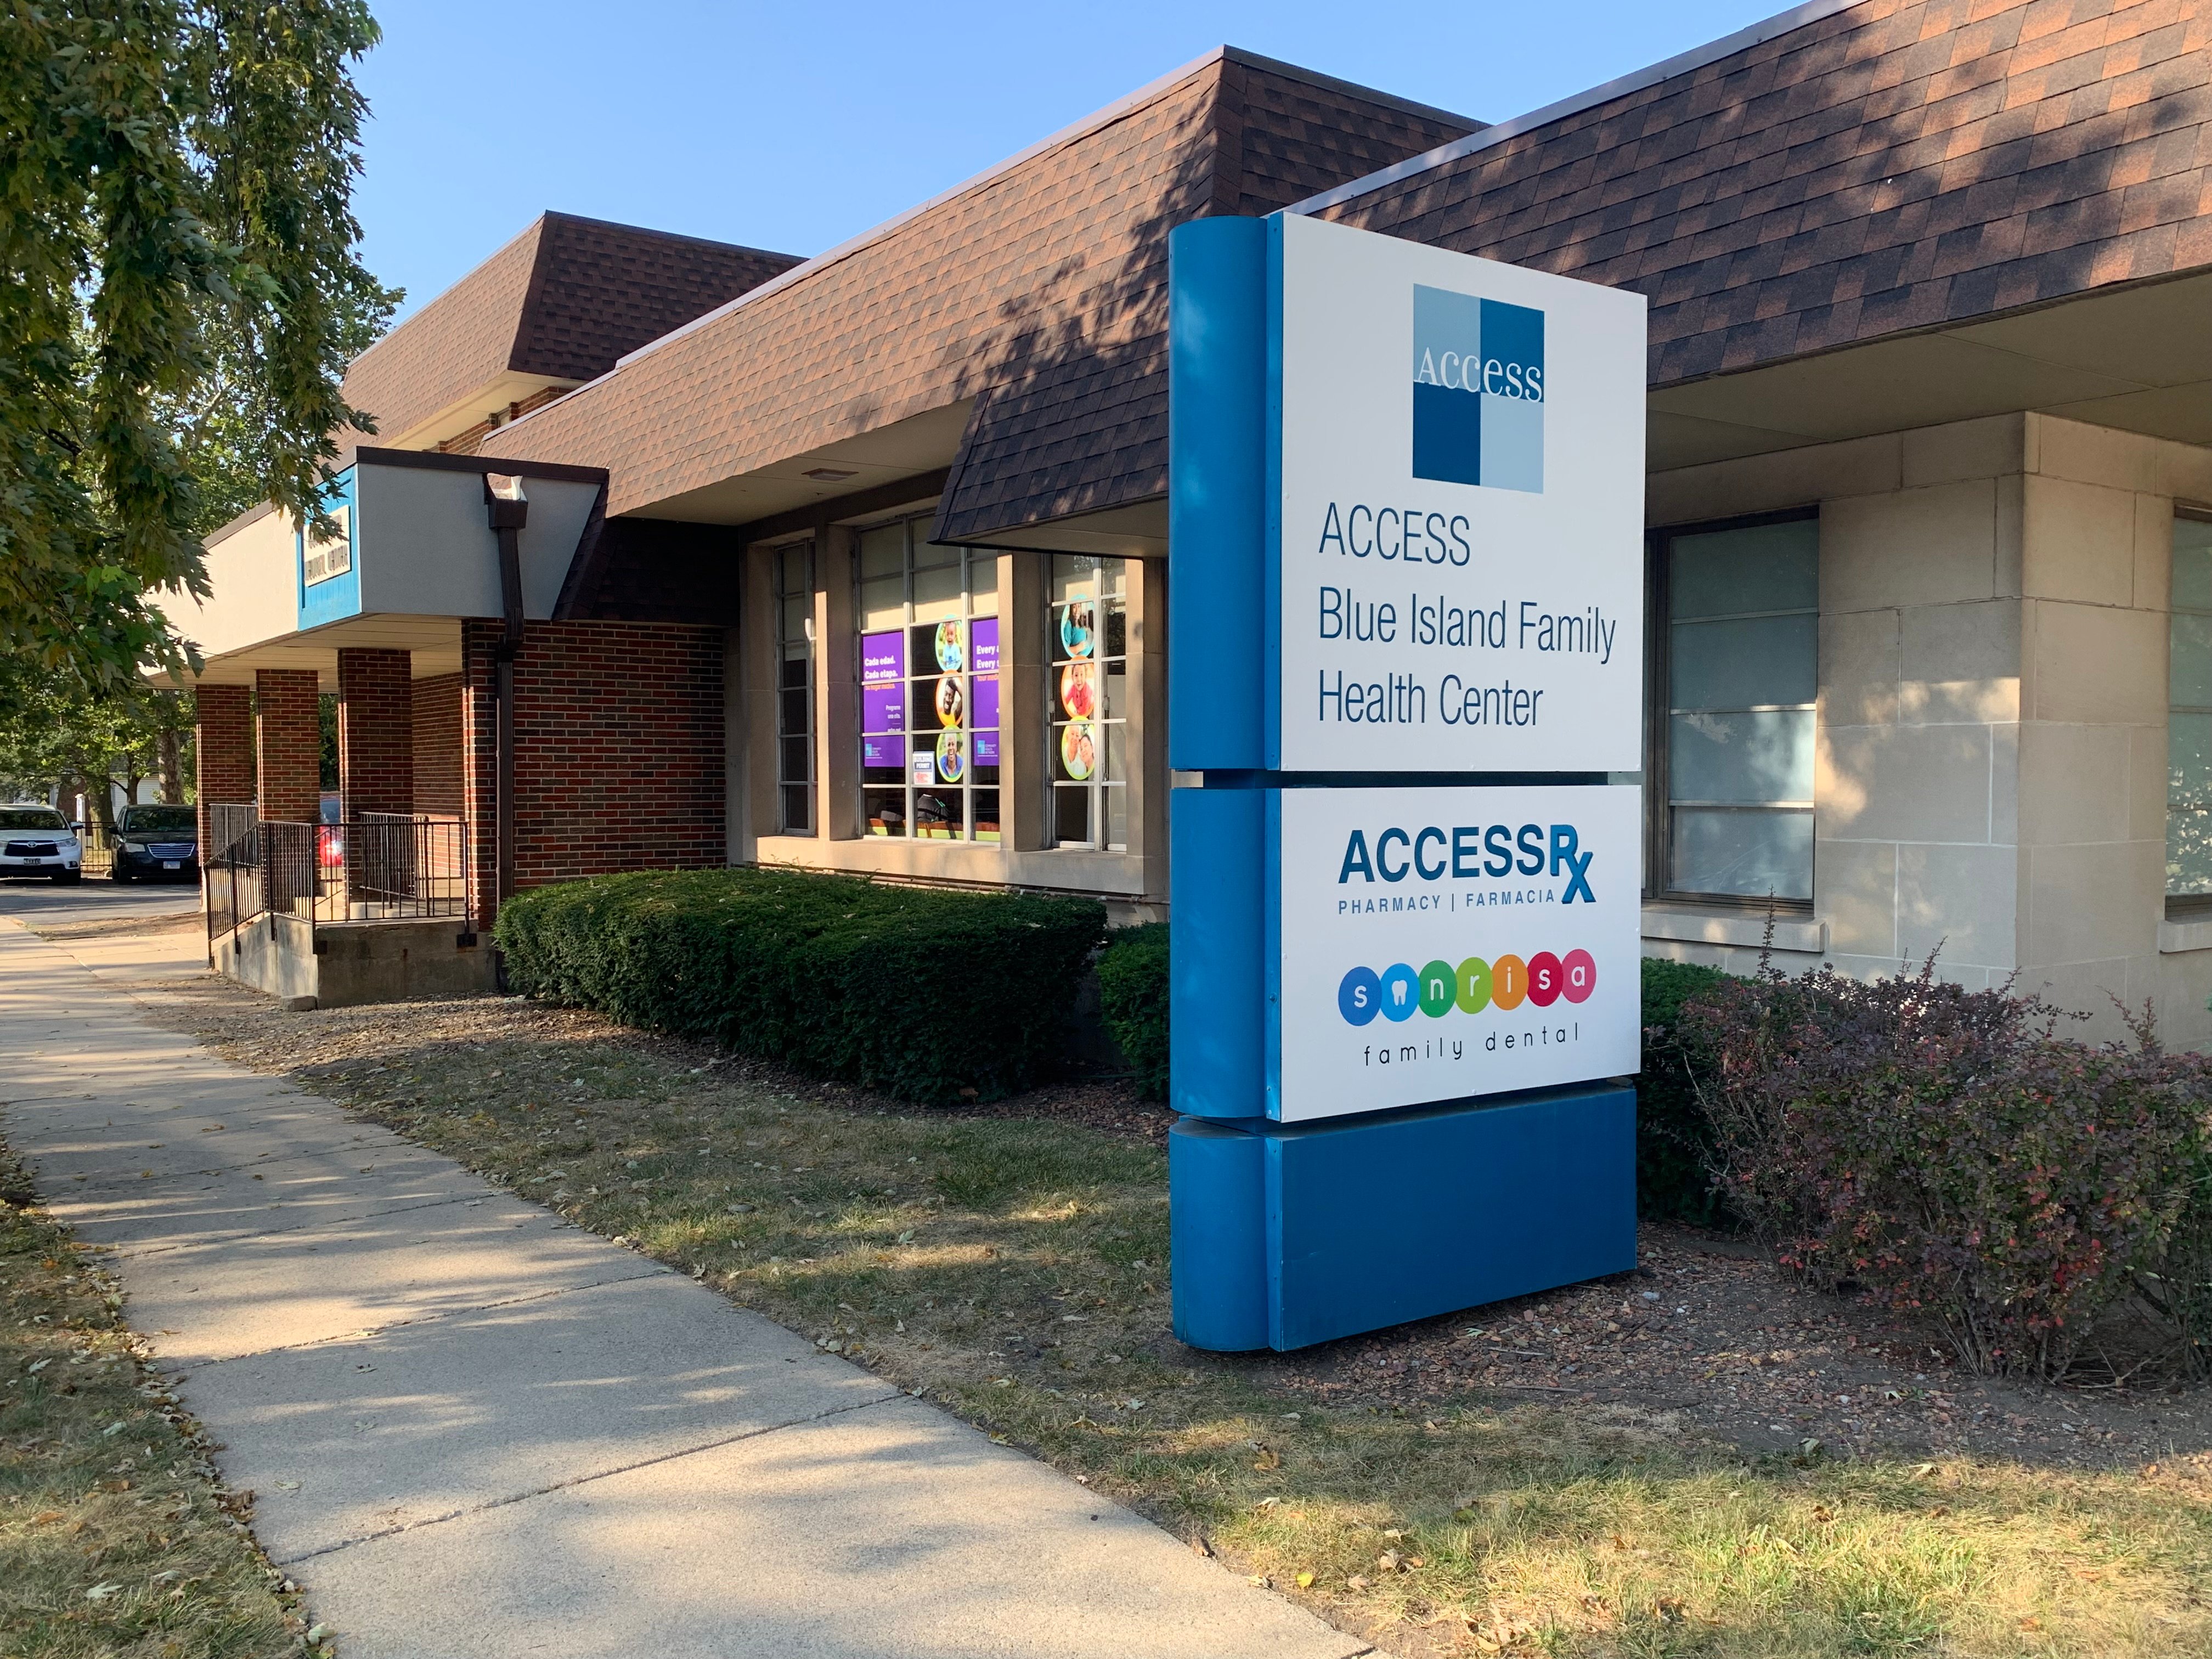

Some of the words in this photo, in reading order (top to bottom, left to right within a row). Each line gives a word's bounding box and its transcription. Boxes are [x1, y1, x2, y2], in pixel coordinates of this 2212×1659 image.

[1318, 501, 1471, 567] ACCESS
[1319, 586, 1397, 643] Blue
[1411, 592, 1507, 649] Island
[1519, 601, 1617, 665] Family
[864, 657, 879, 667] Cada
[879, 654, 896, 665] edad.
[977, 645, 996, 655] Every
[865, 669, 879, 680] Cada
[977, 659, 996, 669] Every
[1319, 669, 1426, 724] Health
[1440, 674, 1544, 726] Center
[1338, 894, 1441, 915] PHARMACY
[1466, 889, 1555, 907] FARMACIA
[1363, 1036, 1463, 1066] family
[1485, 1022, 1579, 1052] dental
